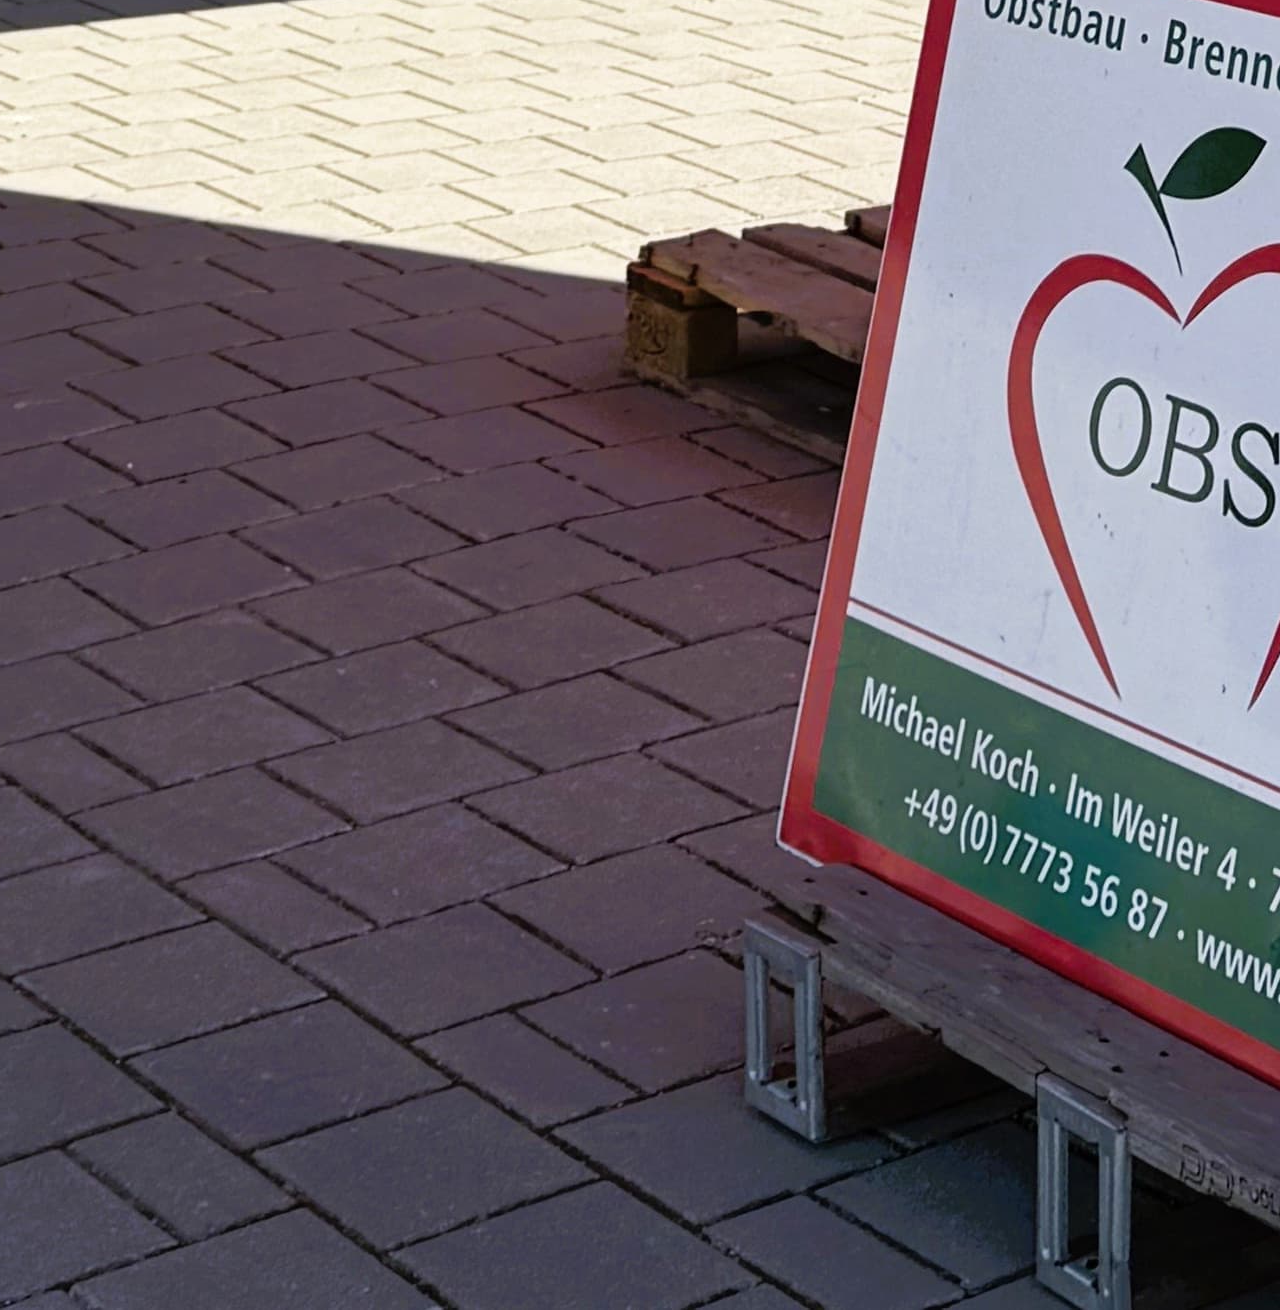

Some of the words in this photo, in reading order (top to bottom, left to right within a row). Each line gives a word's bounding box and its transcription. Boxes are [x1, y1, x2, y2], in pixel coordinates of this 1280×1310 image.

[860, 675, 966, 761] Michael
[971, 729, 1039, 797] Koch
[1065, 772, 1102, 828] Im
[1112, 793, 1209, 877] Weiler
[1216, 846, 1239, 891] 4
[1002, 825, 1073, 894] 7773
[1081, 865, 1119, 918] 56
[1127, 888, 1169, 939] 87
